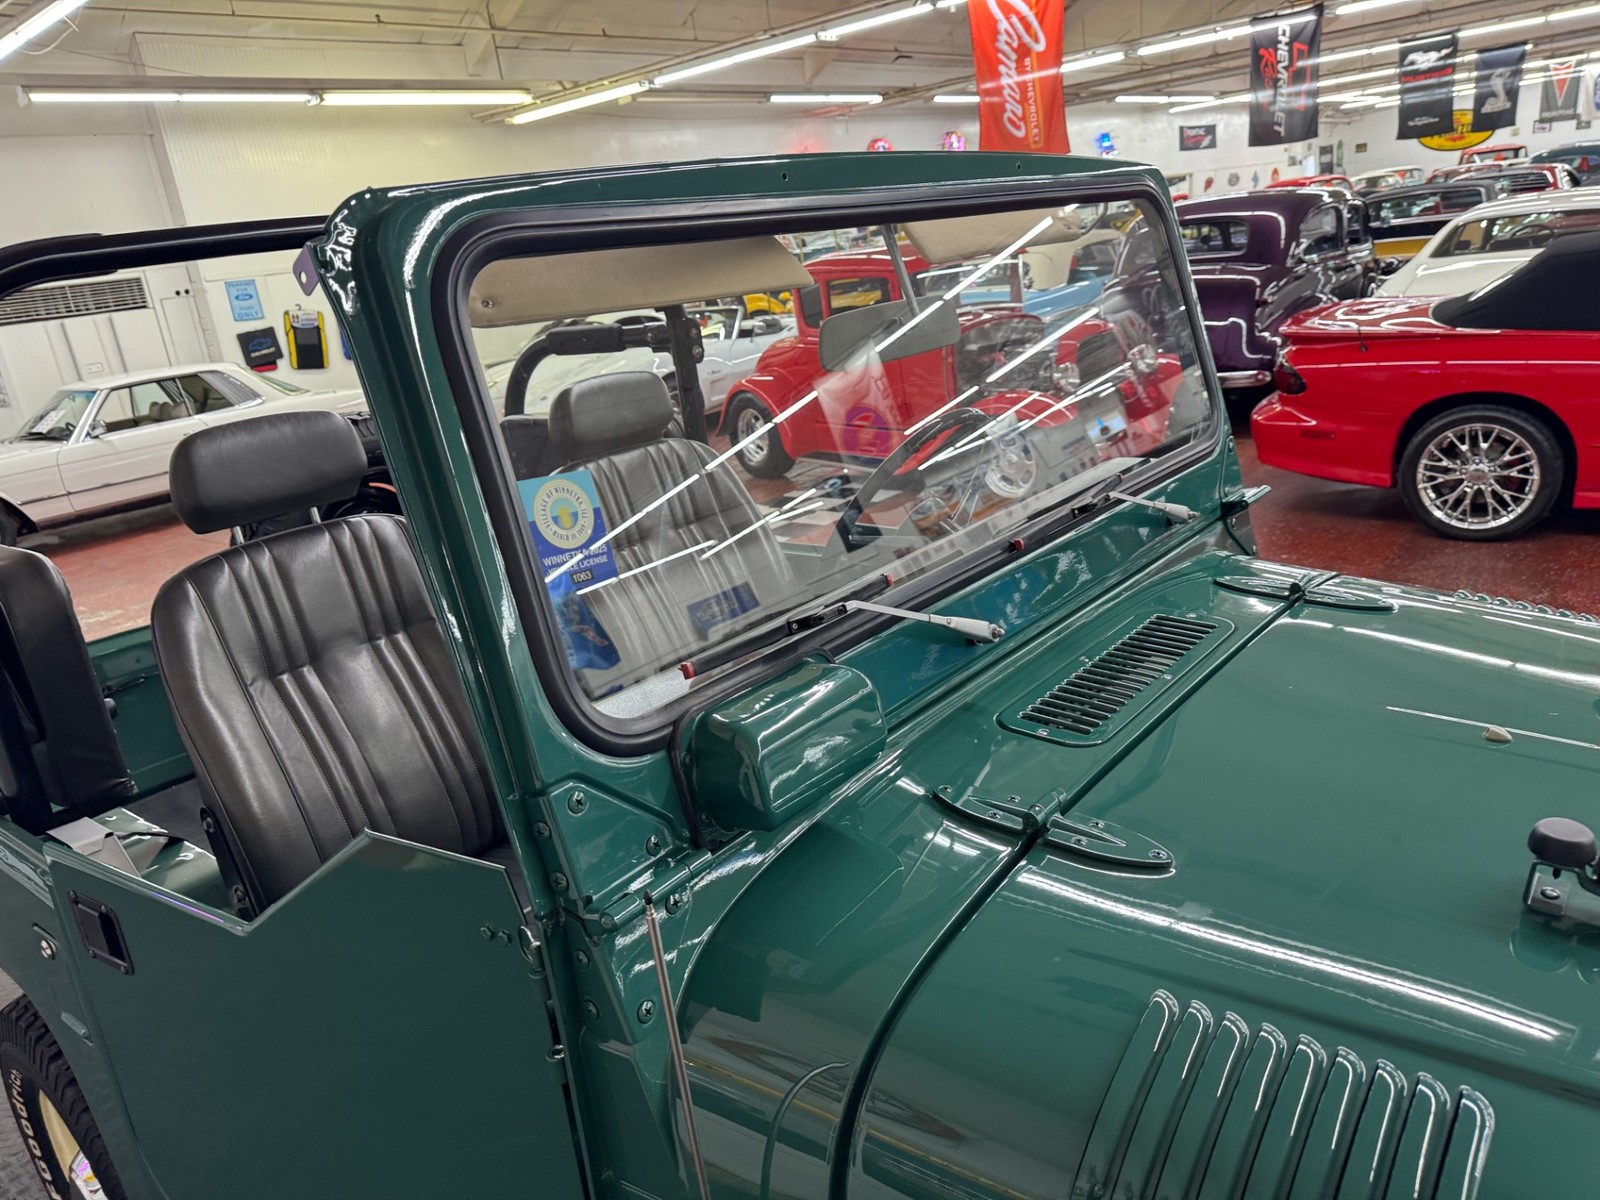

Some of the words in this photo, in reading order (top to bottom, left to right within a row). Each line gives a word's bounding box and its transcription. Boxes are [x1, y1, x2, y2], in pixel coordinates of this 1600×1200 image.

[986, 0, 1046, 138] Camaro
[1024, 57, 1033, 72] BY
[1273, 23, 1291, 138] CHEVROLET
[541, 498, 551, 528] VILLAGE
[546, 489, 554, 499] OF
[542, 549, 588, 566] WINNETKA
[580, 554, 608, 568] LICENSE
[572, 571, 592, 583] 1063
